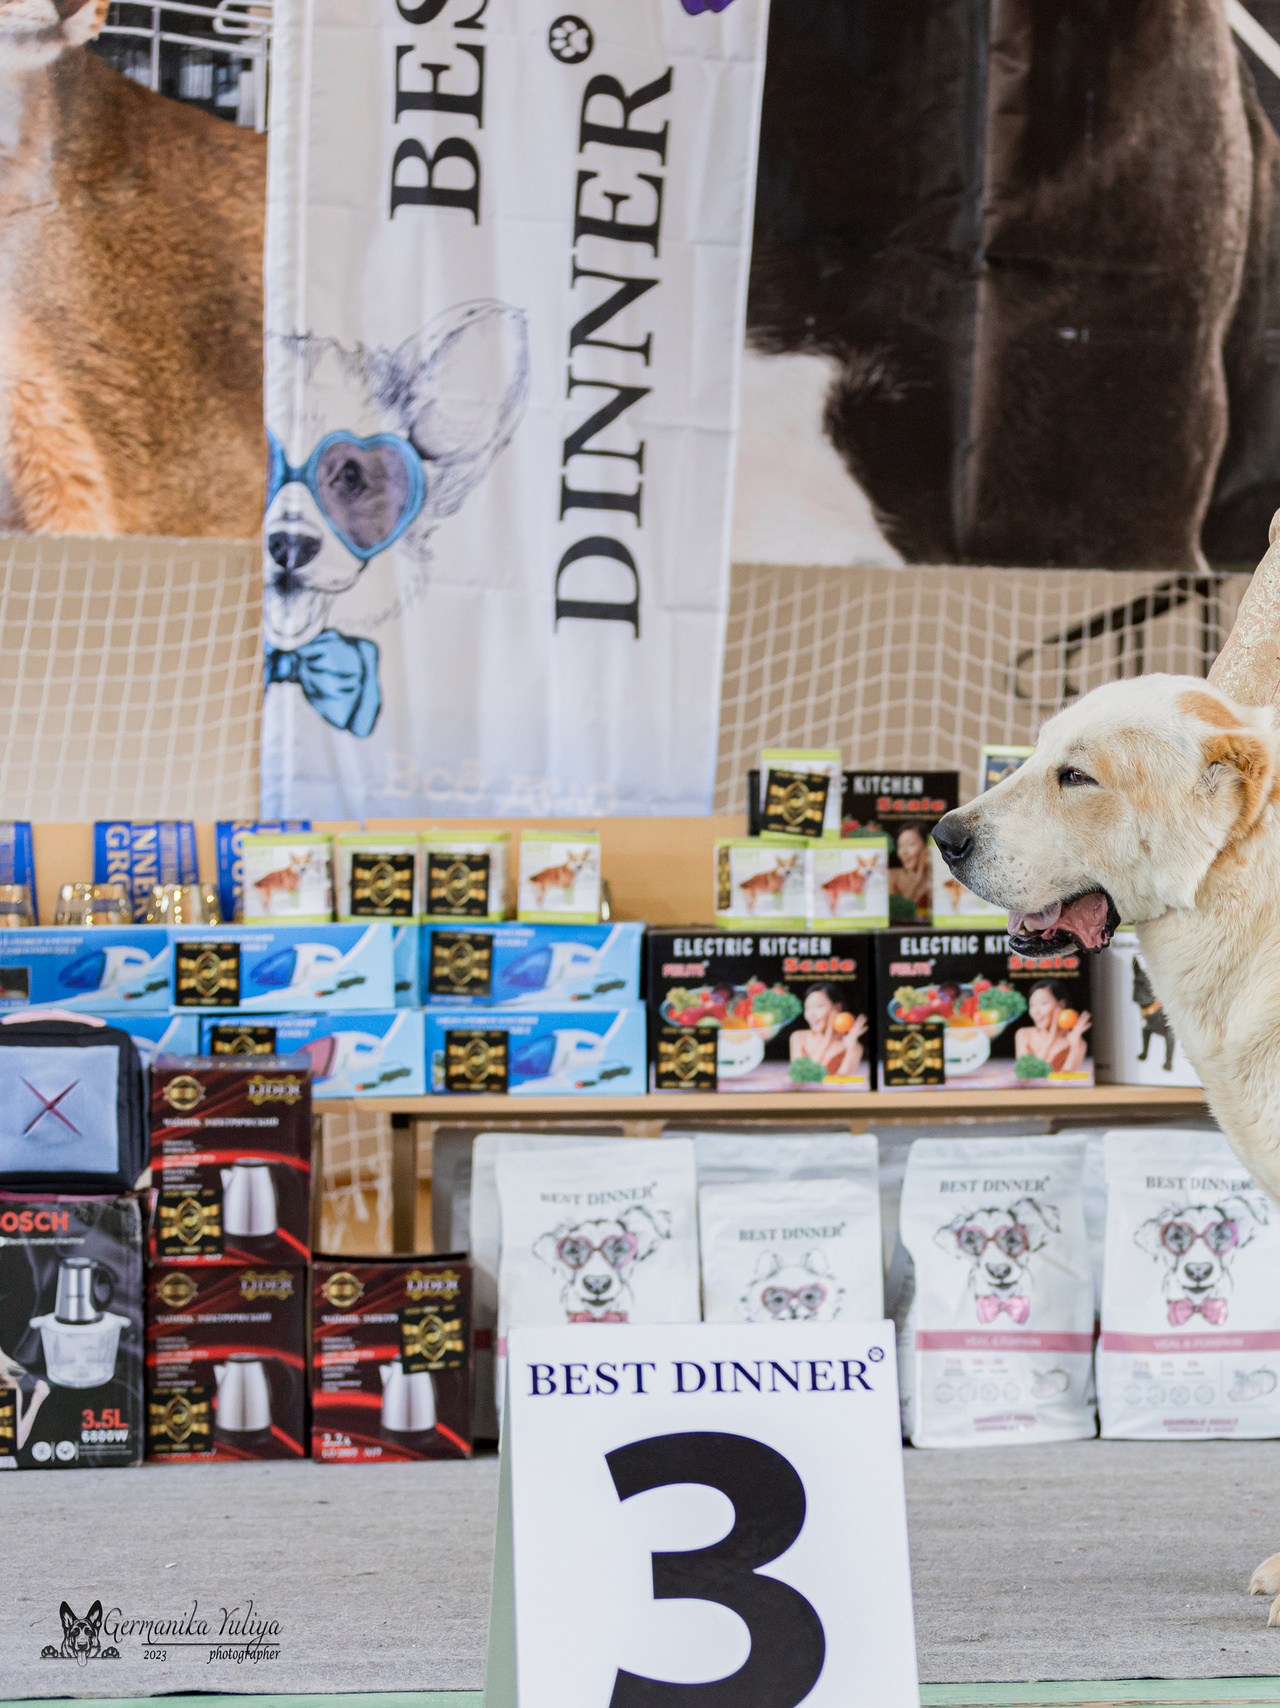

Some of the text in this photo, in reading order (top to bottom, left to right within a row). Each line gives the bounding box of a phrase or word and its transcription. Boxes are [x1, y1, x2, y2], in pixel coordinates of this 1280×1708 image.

[555, 65, 674, 640] DINNER
[853, 775, 925, 795] KITCHEN
[875, 796, 947, 813] Scale
[673, 936, 832, 957] ELECTRIC KITCHEN
[900, 936, 979, 956] ELECTRIC
[782, 956, 857, 973] Scale
[1007, 955, 1080, 970] Scale
[939, 1178, 1047, 1194] BEST DINNER
[1146, 1176, 1187, 1190] BEST
[540, 1185, 655, 1207] BEST DINNER
[0, 1210, 69, 1233] OSCH
[739, 1225, 844, 1242] BEST DINNER
[527, 1358, 876, 1397] BEST DINNER
[81, 1408, 129, 1429] 3.5L
[604, 1430, 827, 1708] 3
